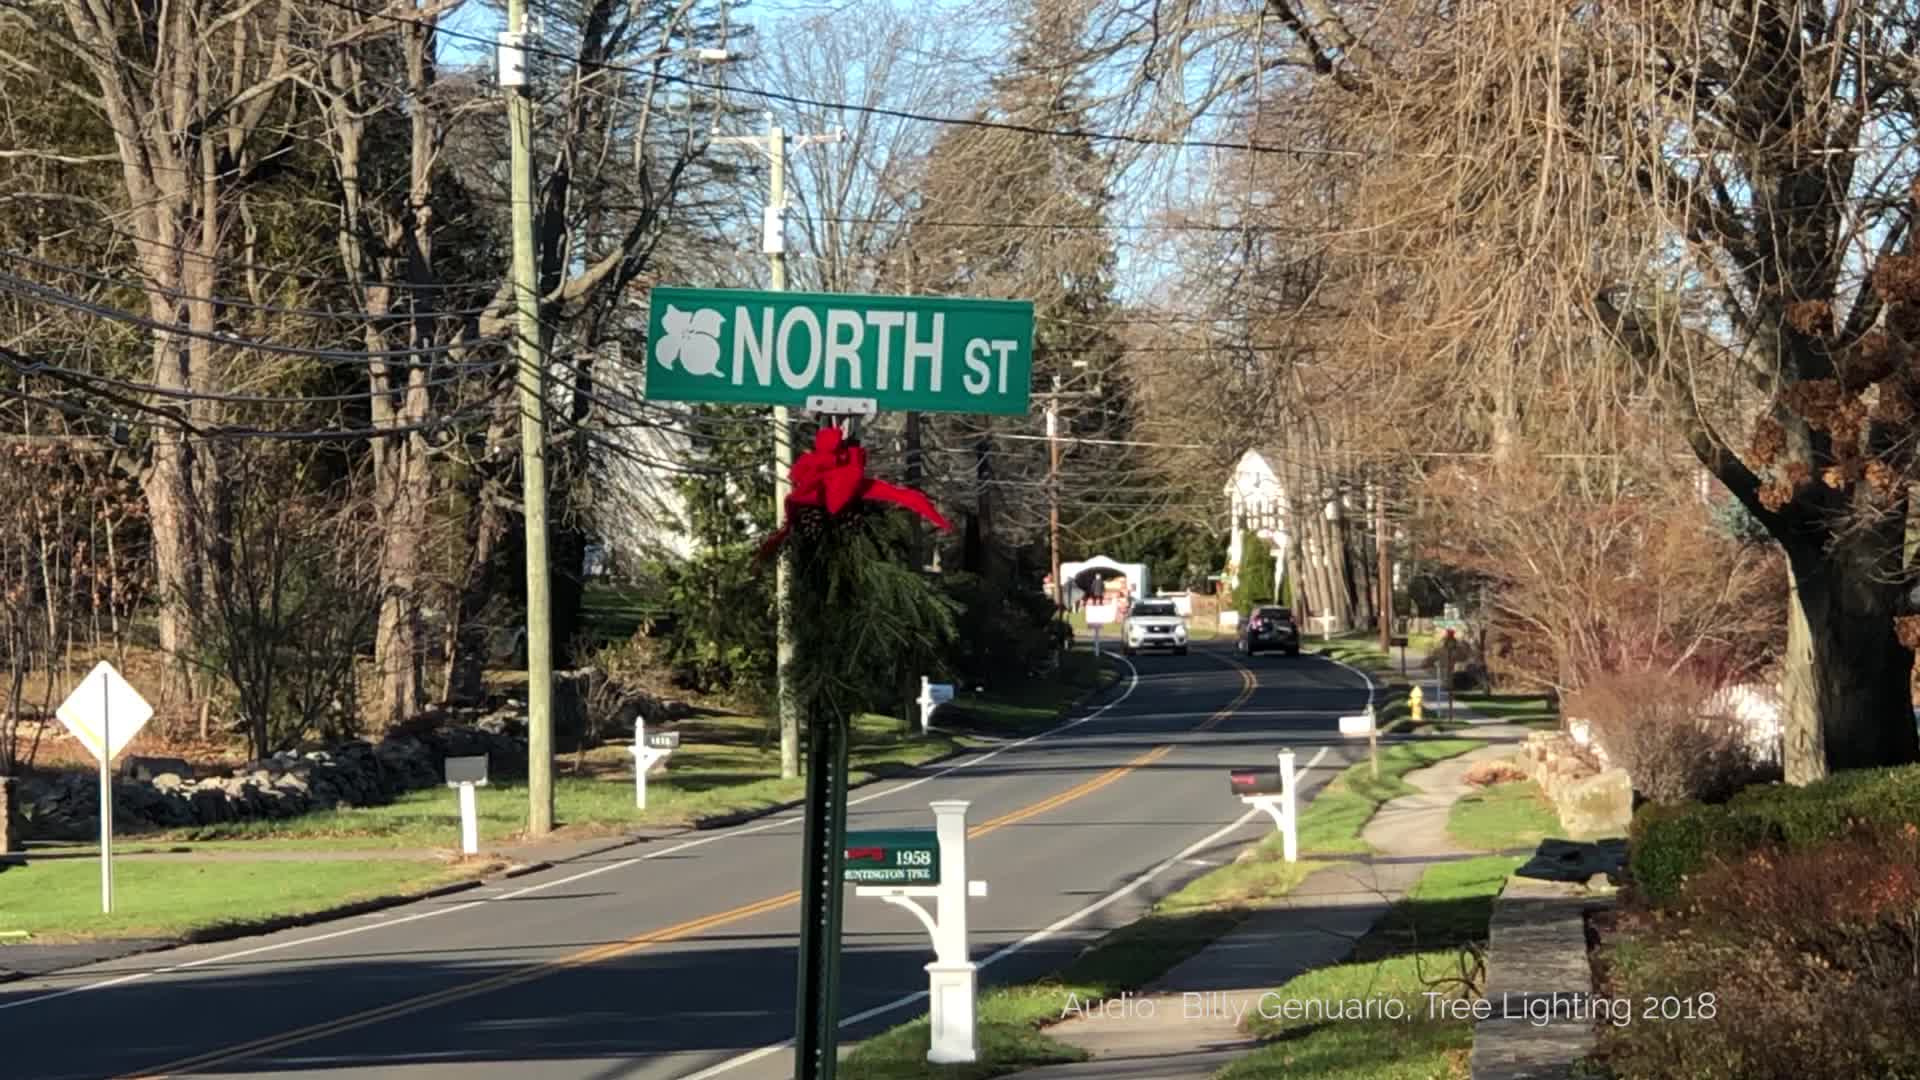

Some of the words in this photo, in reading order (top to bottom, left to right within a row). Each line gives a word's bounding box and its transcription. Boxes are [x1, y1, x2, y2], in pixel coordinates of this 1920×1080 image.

[732, 306, 944, 392] NORTH
[963, 337, 1017, 395] ST
[896, 850, 931, 866] 1958
